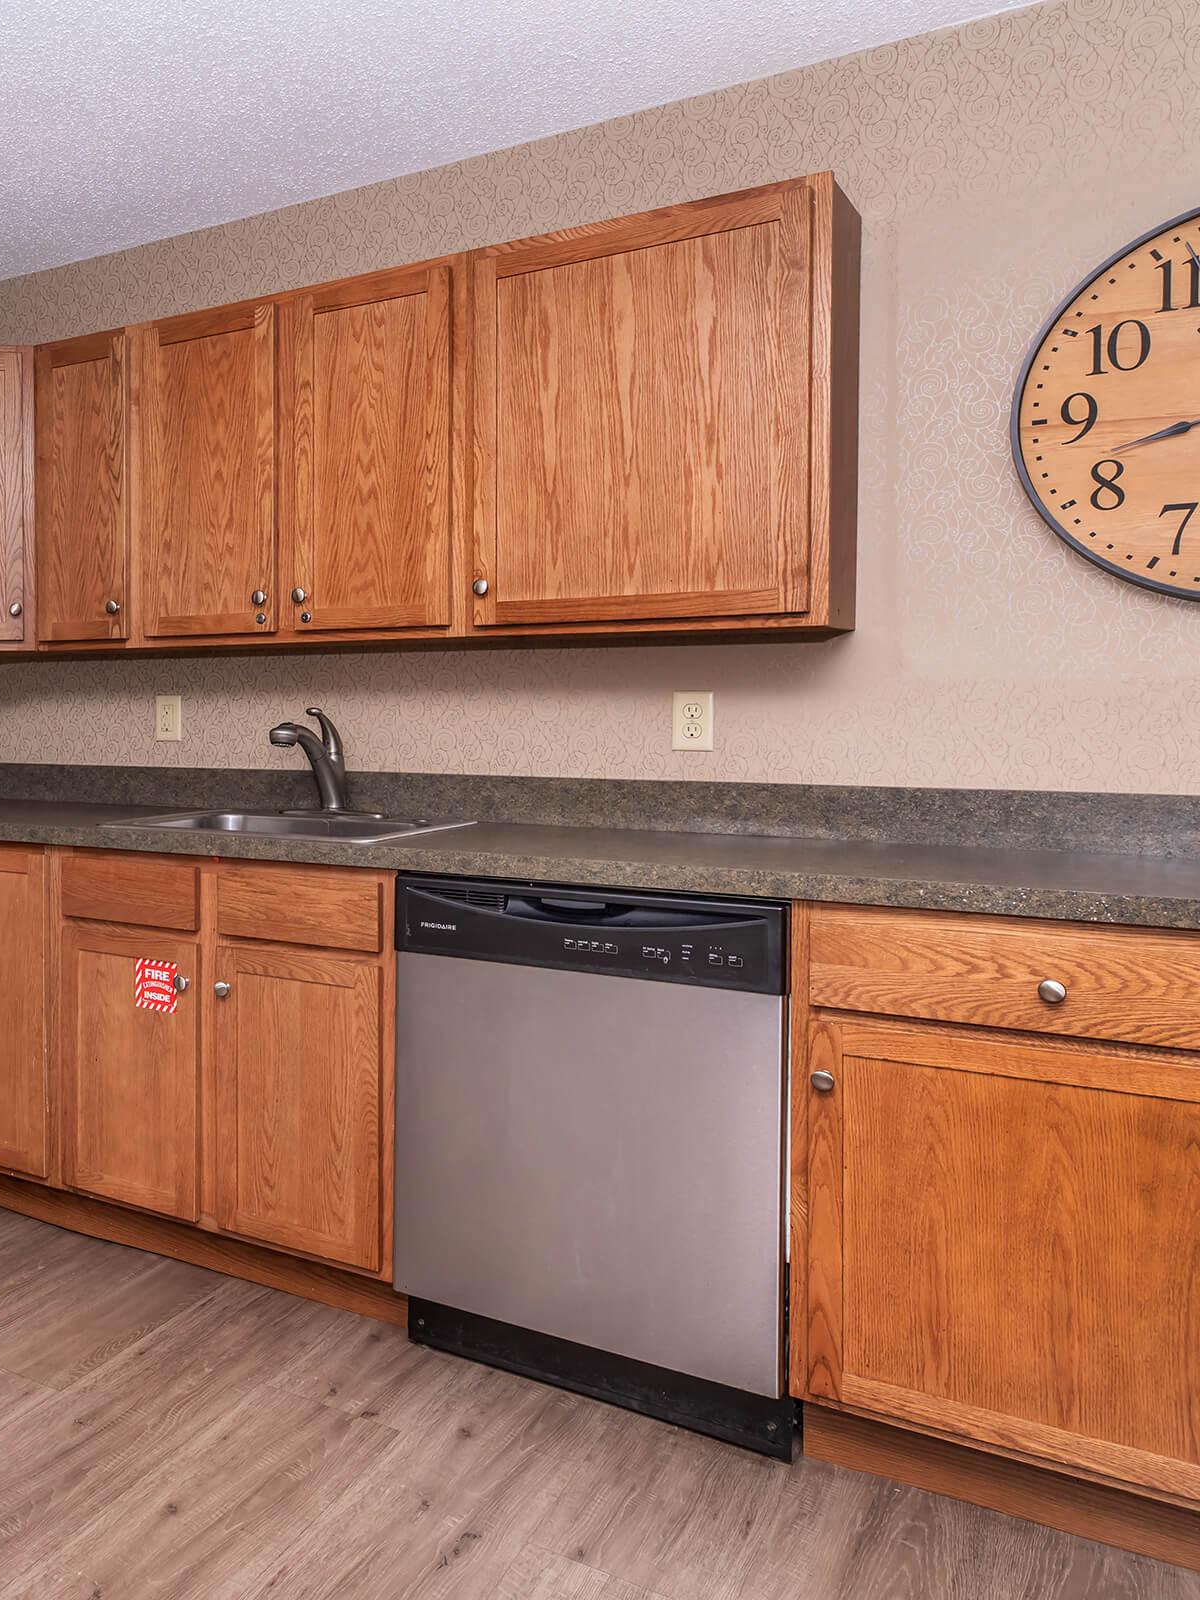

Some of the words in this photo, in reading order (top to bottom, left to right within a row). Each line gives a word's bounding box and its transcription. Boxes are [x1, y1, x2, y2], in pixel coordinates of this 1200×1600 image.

[1153, 256, 1200, 313] 11
[1084, 319, 1151, 377] 10
[1060, 392, 1098, 445] 9
[1089, 459, 1126, 511] 8
[1158, 501, 1199, 555] 7
[420, 921, 457, 931] FRIGIDAIRE
[144, 968, 170, 982] FIRE
[144, 991, 171, 1003] INSIDE
